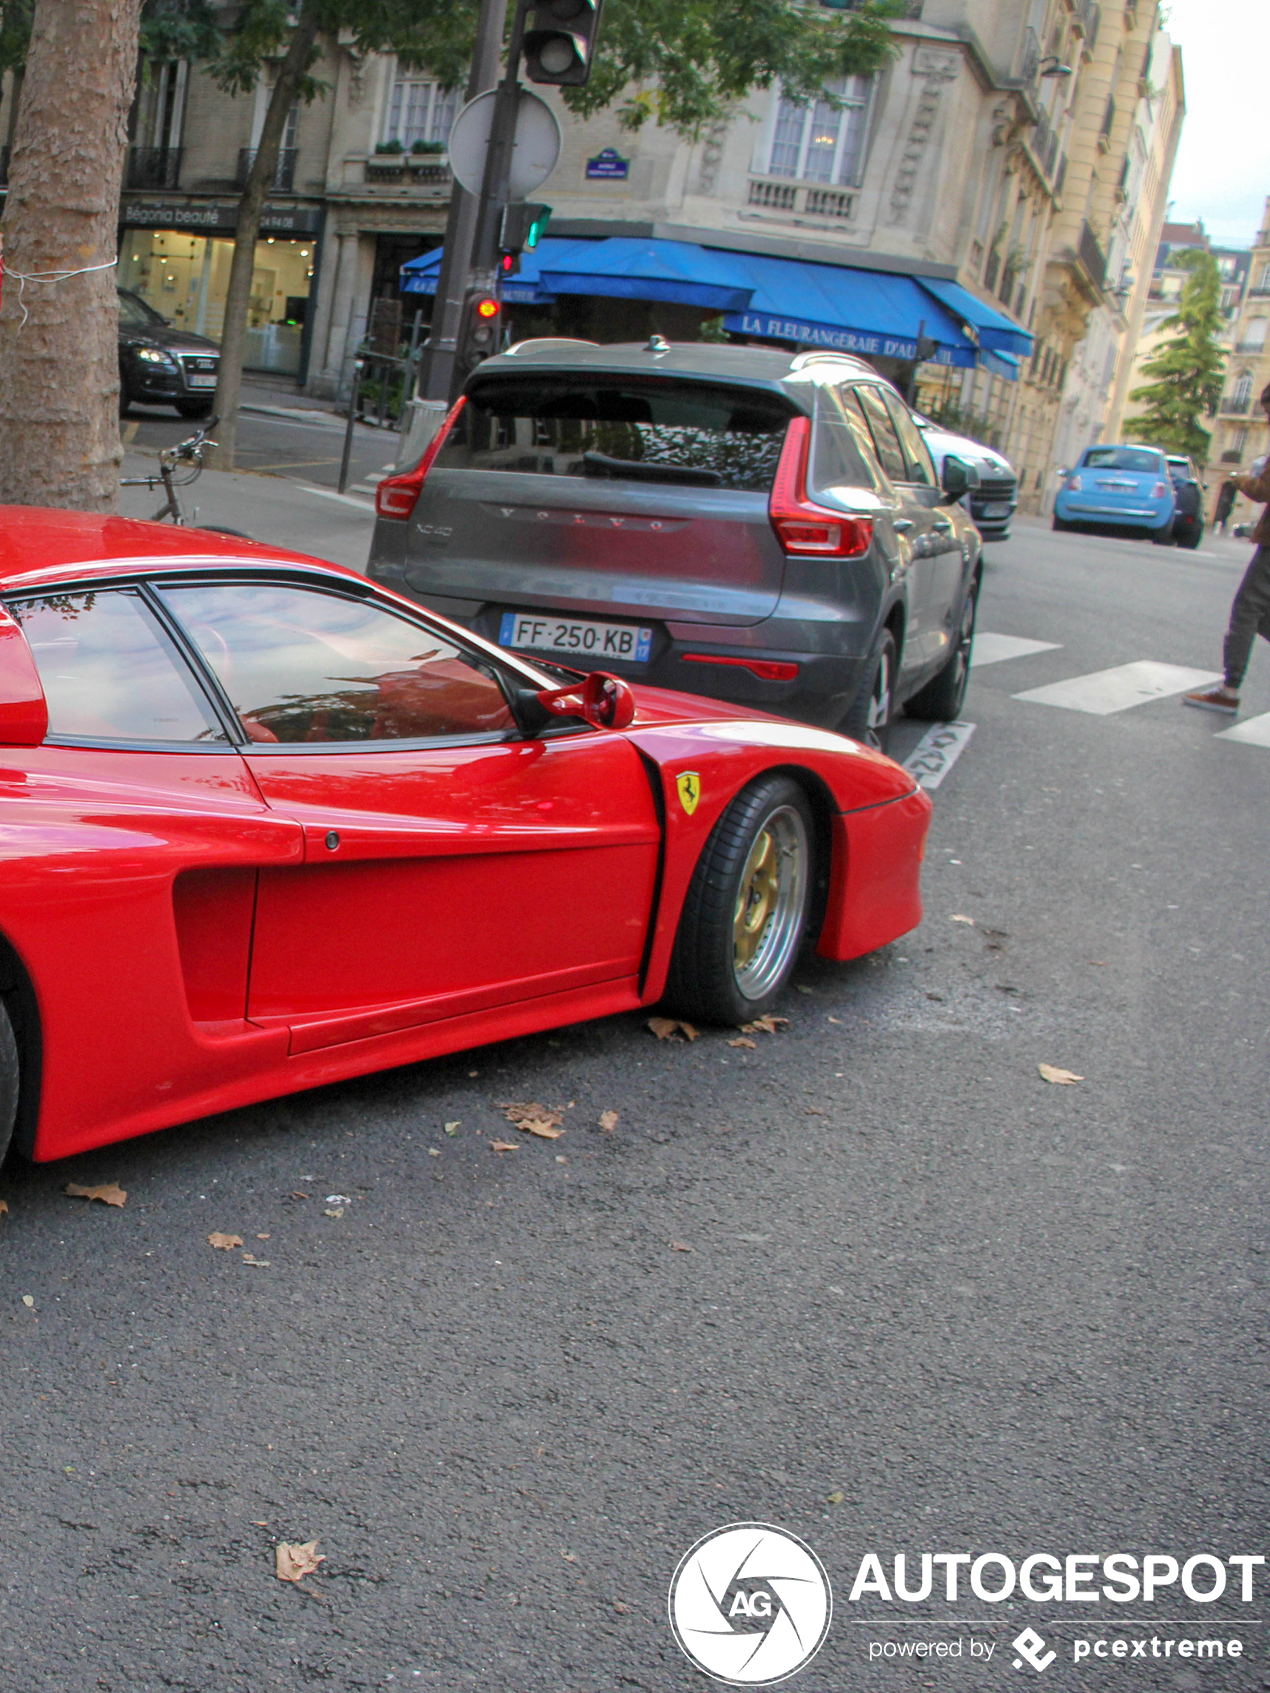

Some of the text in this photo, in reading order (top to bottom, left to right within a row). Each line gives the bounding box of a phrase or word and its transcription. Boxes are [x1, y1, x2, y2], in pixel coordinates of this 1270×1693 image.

[126, 206, 219, 224] Bégonia beauté
[742, 315, 761, 333] LA
[767, 320, 879, 353] FLEURANGERAIE
[501, 508, 663, 531] VOLVO
